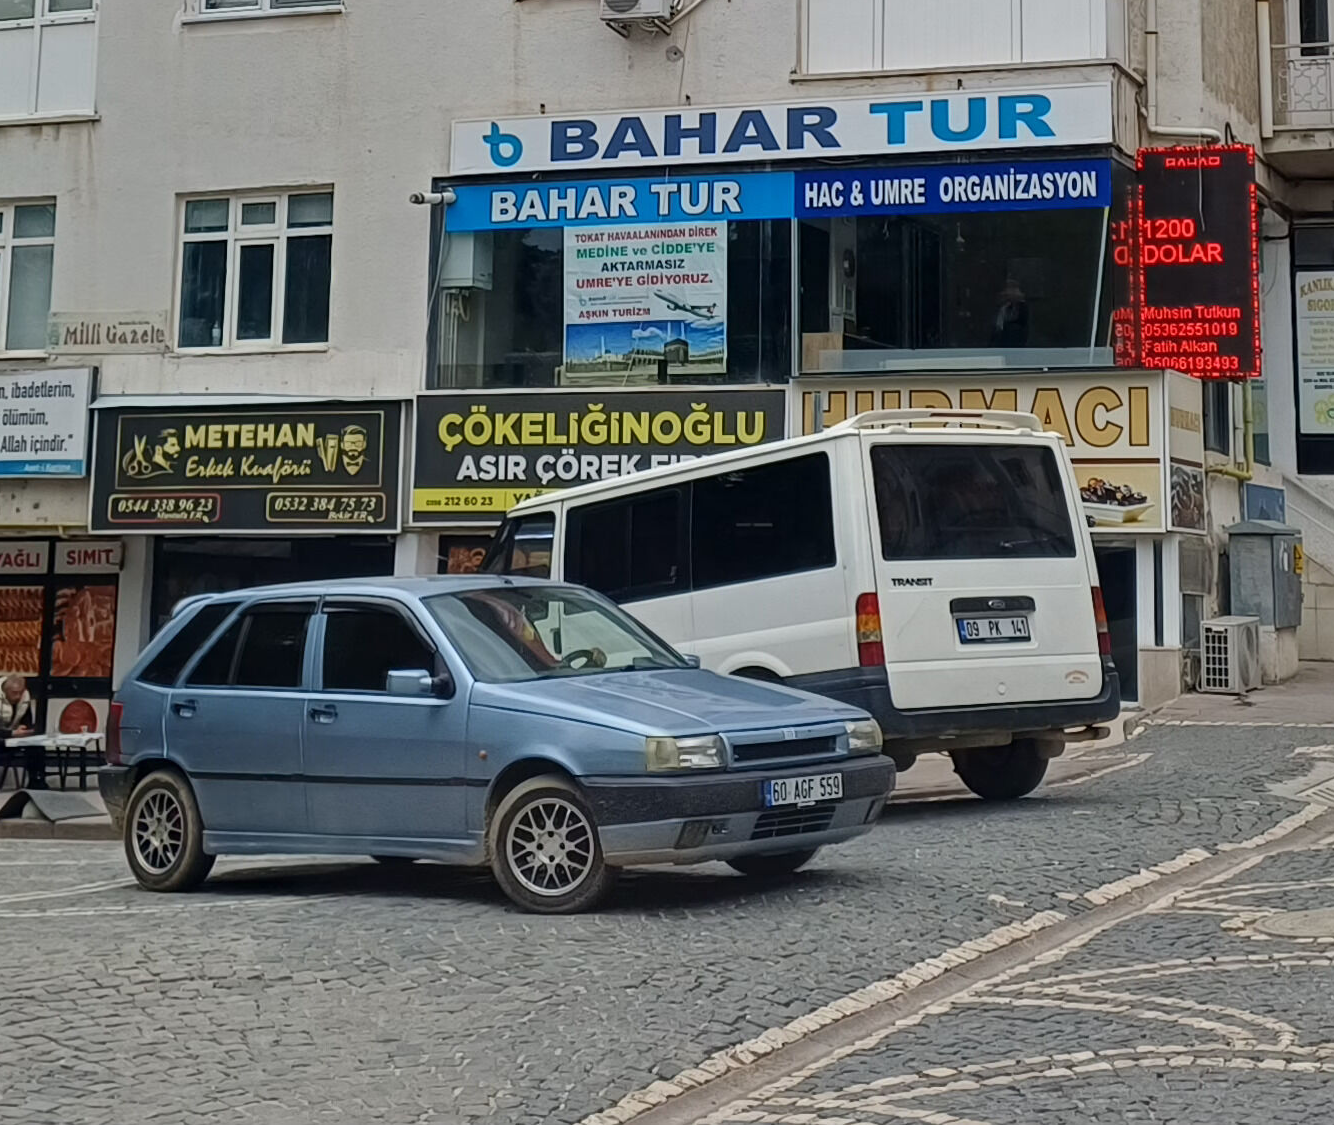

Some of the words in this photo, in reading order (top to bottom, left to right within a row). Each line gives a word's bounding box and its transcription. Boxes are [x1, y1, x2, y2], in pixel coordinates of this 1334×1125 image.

[548, 105, 842, 163] BAHAR
[868, 94, 1057, 146] TUR
[804, 180, 845, 208] HAC
[850, 181, 865, 206] &
[870, 176, 926, 206] UMRE
[939, 166, 1098, 203] ORGANİZASYON
[490, 184, 637, 223] BAHAR
[650, 180, 742, 216] TUR
[575, 233, 605, 243] TOKAT
[607, 229, 686, 241] HAVAALANINDAN
[689, 226, 717, 236] DİREK
[1143, 219, 1194, 238] 1200
[576, 245, 628, 259] MEDİNE
[632, 248, 647, 256] ve
[651, 242, 715, 255] CİDDE'YE
[1144, 243, 1223, 264] DOLAR
[601, 259, 685, 272] AKTARMASIZ
[576, 276, 633, 289] UMRE'YE
[637, 273, 713, 286] GİDİYORUZ.
[578, 309, 609, 320] AŞKIN
[612, 307, 651, 317] TURİZM
[1144, 307, 1192, 319] Muhsin
[1145, 323, 1238, 336] 05362551019
[1145, 341, 1177, 353] Fatih
[802, 386, 1150, 447] HACI
[0, 433, 27, 453] Allah
[184, 423, 315, 448] METEHAN
[185, 455, 234, 477] Erkek
[240, 455, 311, 484] Kuaförü
[456, 454, 527, 481] ASIR
[535, 448, 642, 485] ÇÖREK
[118, 499, 149, 512] 0544
[151, 499, 175, 512] 338
[178, 498, 194, 511] 96
[197, 498, 213, 511] 23
[274, 497, 308, 511] 0532
[310, 497, 336, 511] 384
[340, 497, 356, 511] 75
[360, 497, 376, 511] 73
[444, 496, 461, 506] 212
[464, 496, 478, 506] 60
[480, 496, 493, 506] 23
[891, 577, 934, 586] TRANSIT
[967, 621, 979, 637] 09
[989, 620, 1002, 636] PK
[1011, 620, 1027, 635] 141
[773, 781, 787, 802] 60
[794, 779, 814, 801] AGF
[820, 776, 840, 797] 559
